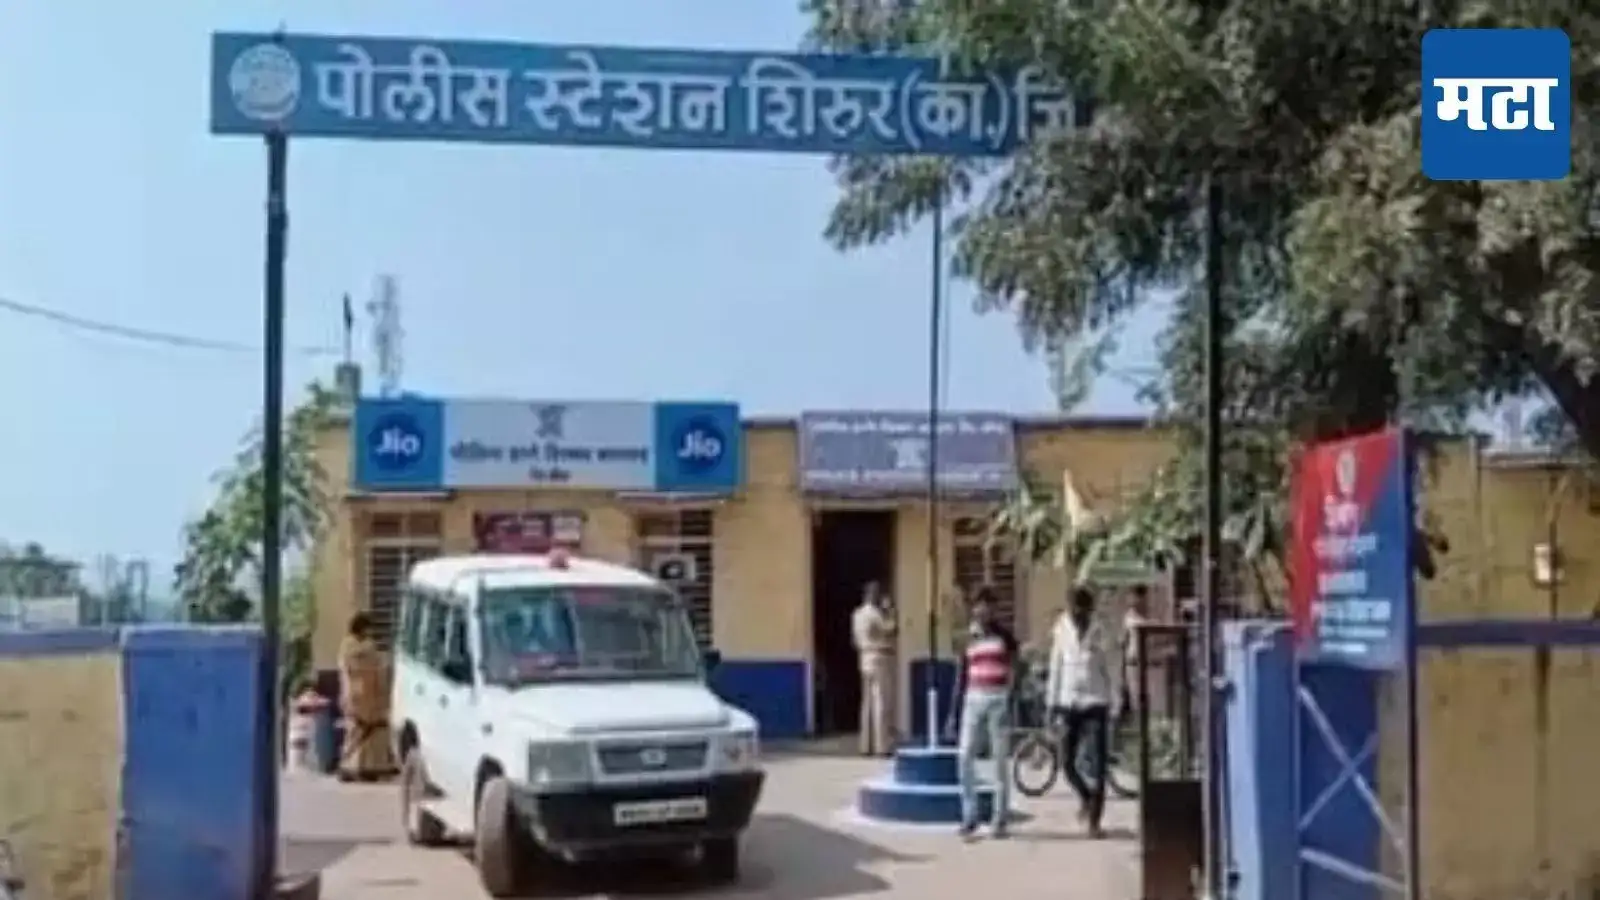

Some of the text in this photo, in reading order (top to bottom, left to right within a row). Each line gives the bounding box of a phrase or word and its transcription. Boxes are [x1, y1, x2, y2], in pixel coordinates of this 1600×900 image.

[312, 43, 511, 128] पोलीस
[522, 51, 732, 136] स्टेशन
[375, 426, 421, 457] Jio
[676, 429, 722, 459] Jio
